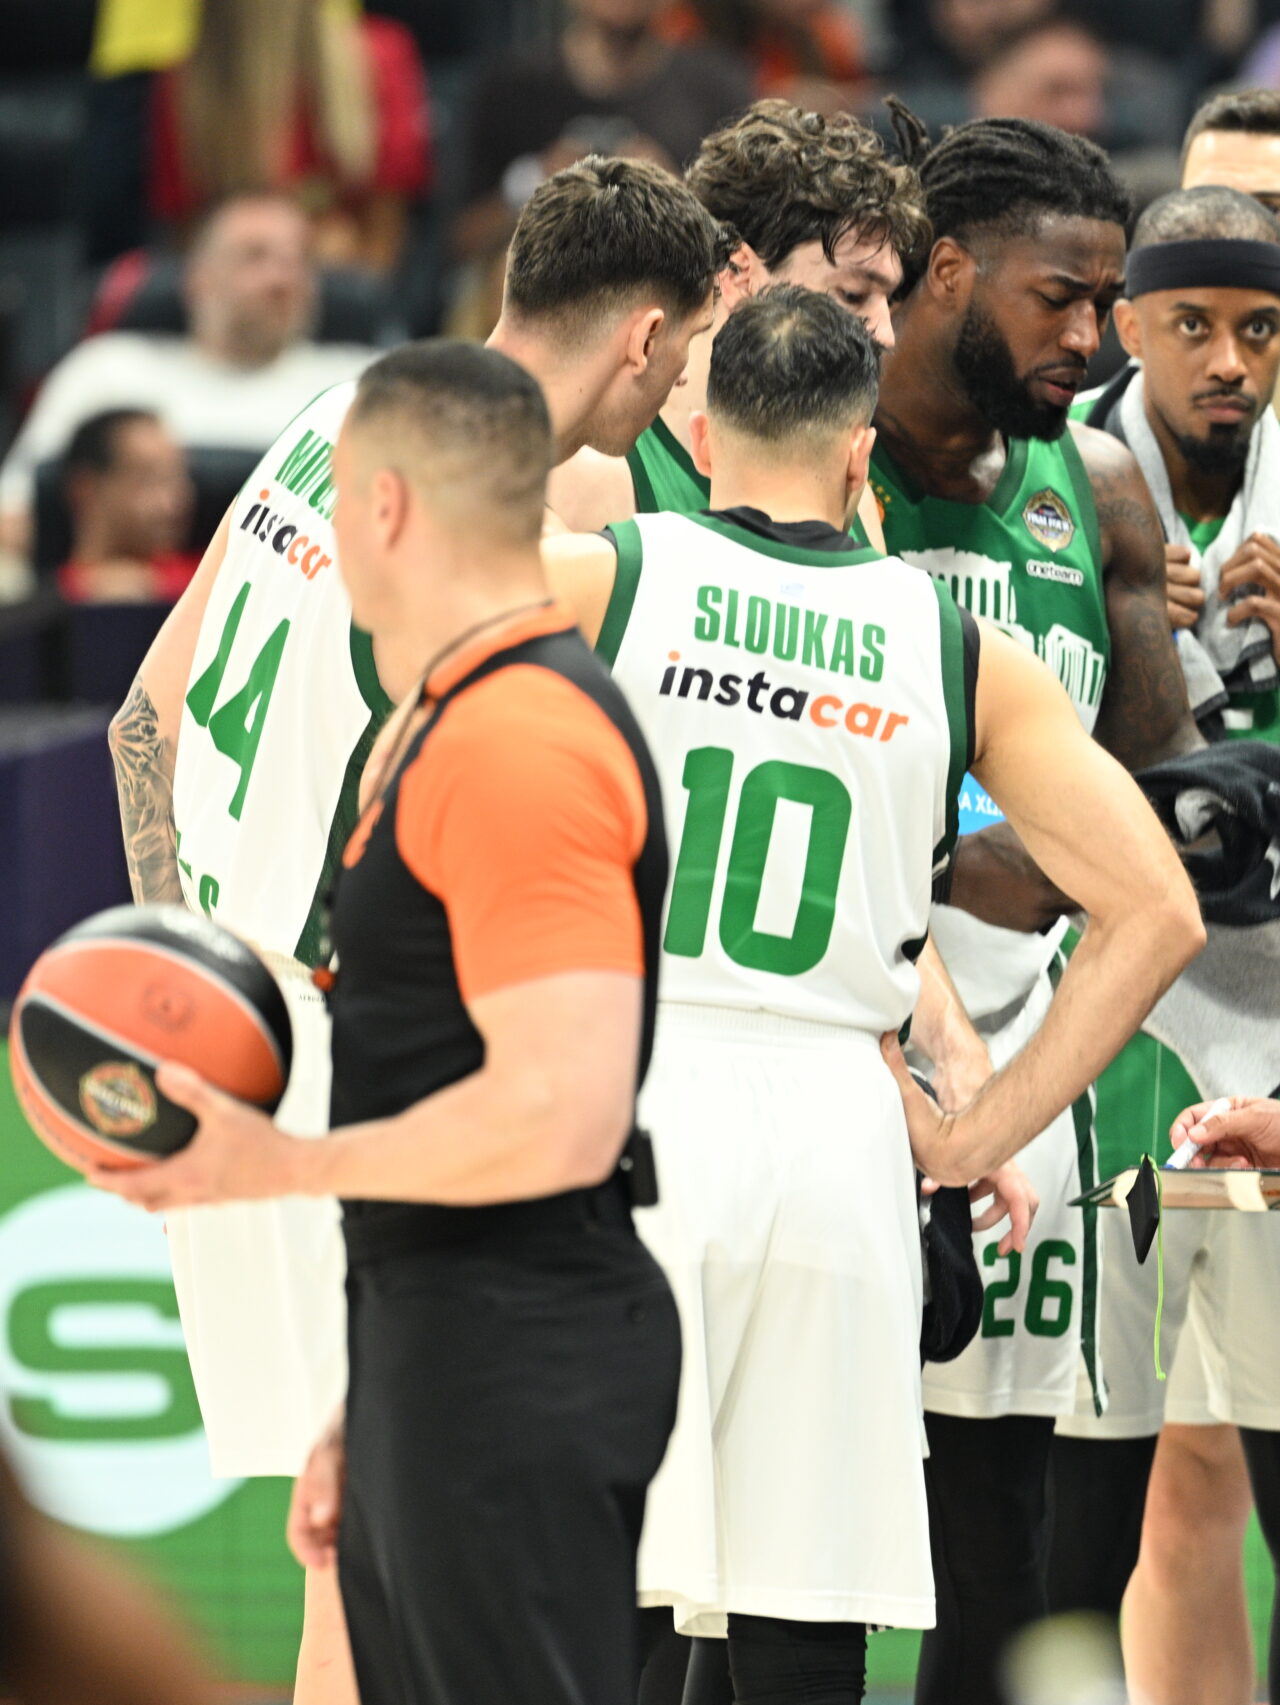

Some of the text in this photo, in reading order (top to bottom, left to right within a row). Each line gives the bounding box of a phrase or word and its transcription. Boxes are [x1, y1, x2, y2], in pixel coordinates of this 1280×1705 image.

[694, 584, 886, 683] SLOUKAS
[658, 650, 910, 742] instacar
[663, 746, 852, 976] 10
[981, 1239, 1076, 1338] 26
[7, 1277, 205, 1441] S
